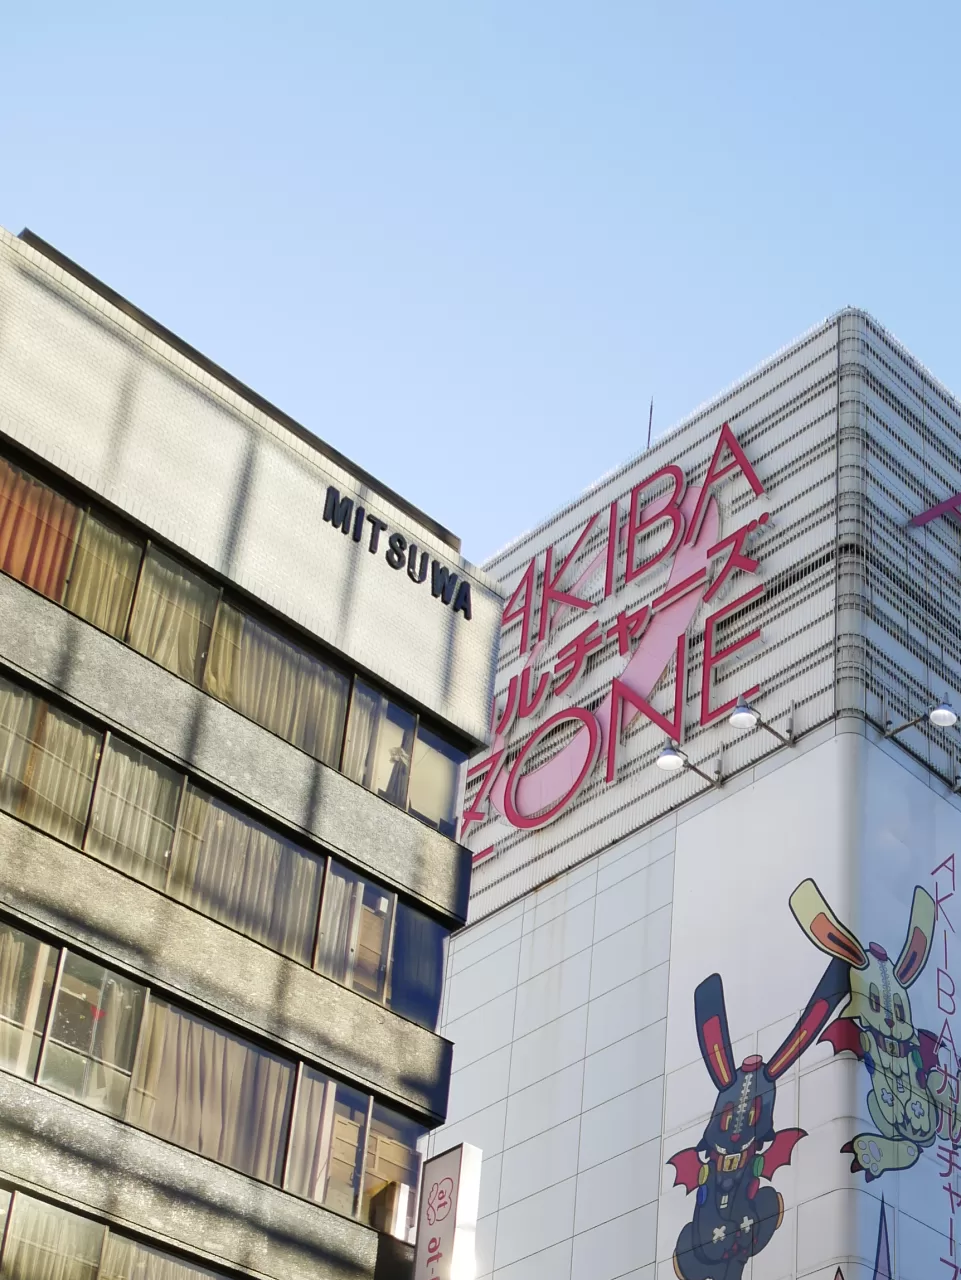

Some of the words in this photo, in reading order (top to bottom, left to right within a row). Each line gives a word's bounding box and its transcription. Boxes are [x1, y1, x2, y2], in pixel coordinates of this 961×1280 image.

[323, 485, 472, 621] MITSUWA
[492, 512, 771, 735] ルチャーズ
[502, 422, 766, 658] AKIBA
